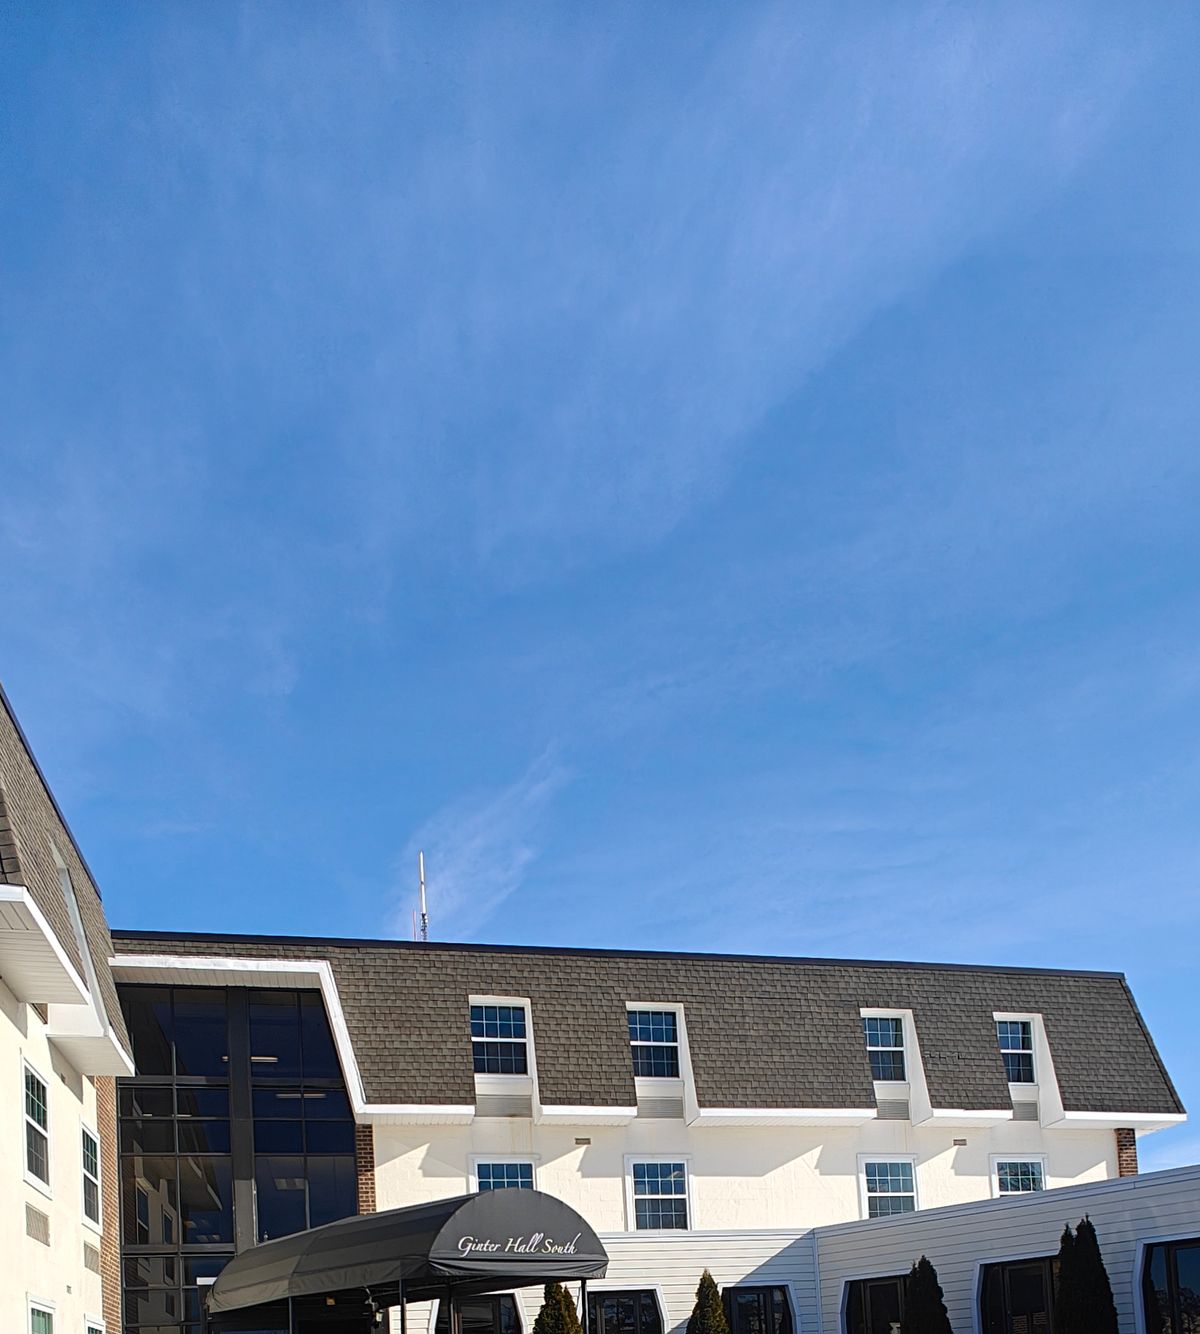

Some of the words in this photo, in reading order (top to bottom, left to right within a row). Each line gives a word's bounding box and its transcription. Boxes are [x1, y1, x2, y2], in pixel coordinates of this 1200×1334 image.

[458, 1236, 501, 1258] Ginter
[505, 1232, 544, 1254] Hall
[541, 1232, 582, 1255] South
